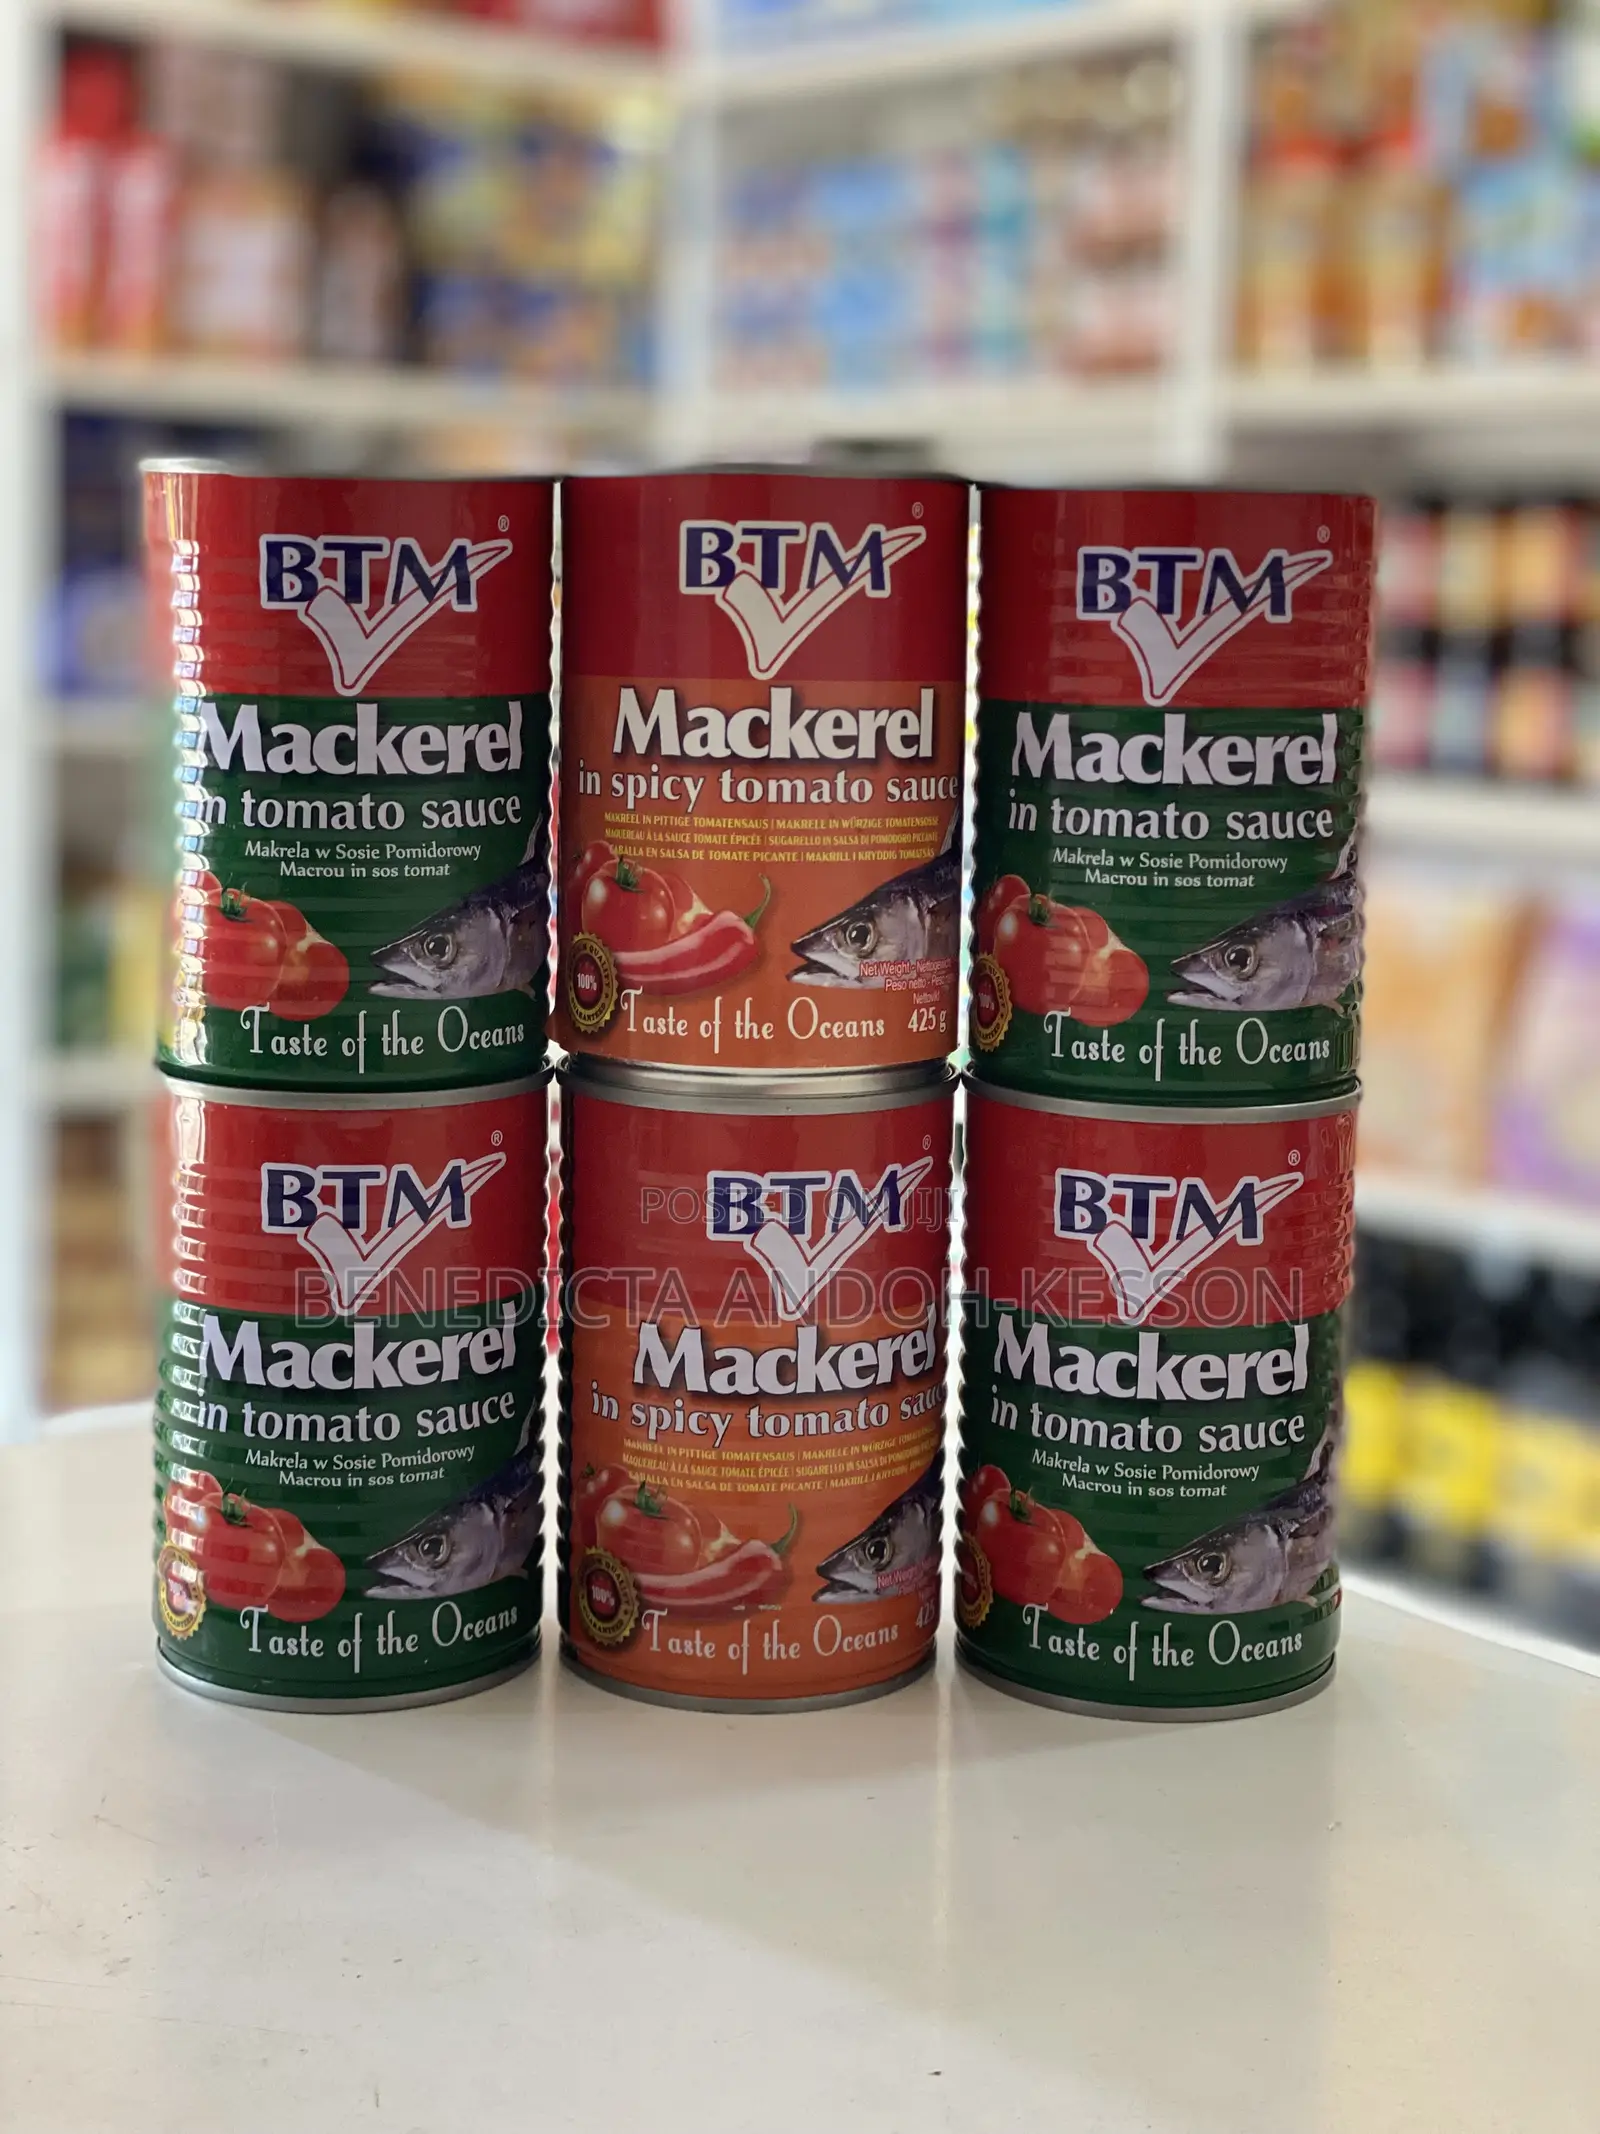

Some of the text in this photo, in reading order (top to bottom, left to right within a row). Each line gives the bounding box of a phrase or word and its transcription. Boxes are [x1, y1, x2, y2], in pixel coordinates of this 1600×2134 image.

[264, 537, 474, 606] BTM
[683, 524, 889, 593] BTM
[1080, 551, 1288, 618] BTM
[198, 701, 523, 775] Mackerel
[612, 686, 935, 759] Mackerel
[1011, 711, 1338, 786] Mackerel
[241, 789, 405, 830] tomato
[421, 794, 522, 829] sauce
[578, 761, 959, 813] in spicy tomato sauce
[1008, 789, 1334, 840] in tomato sauce
[653, 815, 690, 827] PITTIGE
[693, 816, 769, 829] TOMATENSAUS
[829, 818, 839, 829] IN
[653, 833, 663, 842] LA
[665, 832, 691, 844] SAUCE
[693, 833, 729, 844] TOMATE
[833, 835, 859, 845] SALSA
[244, 840, 481, 860] Makrela w Sosie Pomidorowy
[280, 862, 450, 878] Macrou in sos tomat
[660, 849, 690, 860] SALSA
[692, 850, 705, 860] DE
[709, 851, 750, 861] TOMATE
[753, 852, 798, 862] PICANTE
[1053, 847, 1288, 874] Makrela w Sosie Pomidorowy
[1085, 868, 1256, 888] Macrou in sos tomat
[577, 973, 597, 991] 100%
[860, 963, 877, 976] Net
[879, 962, 910, 976] Weight
[885, 978, 907, 991] Peso
[240, 1002, 525, 1074] Taste of the Oceans
[620, 986, 885, 1053] Taste of the Oceans
[907, 1006, 946, 1033] 425 g
[1043, 1006, 1330, 1082] Taste of the Oceans
[264, 1166, 473, 1230] BTM
[710, 1169, 904, 1237] BTM
[1057, 1172, 1260, 1241] BTM
[199, 1300, 516, 1391] Mackerel
[633, 1302, 937, 1396] Mackerel
[994, 1312, 1310, 1401] Mackerel
[197, 1388, 515, 1443] in tomato sauce
[591, 1381, 619, 1421] in
[631, 1399, 732, 1448] spicy
[747, 1397, 890, 1438] tomato
[900, 1385, 943, 1420] sauc
[991, 1385, 1305, 1453] in tomato sauce
[244, 1445, 475, 1471] Makrela w Sosie Pomidorowy
[278, 1466, 445, 1487] Macrou in sos tomat
[679, 1448, 717, 1460] PITTIGE
[721, 1451, 795, 1461] TOMATENSAUS
[1031, 1449, 1260, 1483] Makrela w Sosie Pomidorowy
[685, 1479, 717, 1491] SALSA
[1062, 1474, 1227, 1498] Macrou in sos tomat
[239, 1600, 518, 1674] Taste of the Oceans
[641, 1609, 716, 1659] Taste
[728, 1619, 751, 1675] of
[763, 1620, 800, 1659] the
[813, 1615, 899, 1656] Oceans
[1022, 1603, 1303, 1681] Taste of the Oceans
